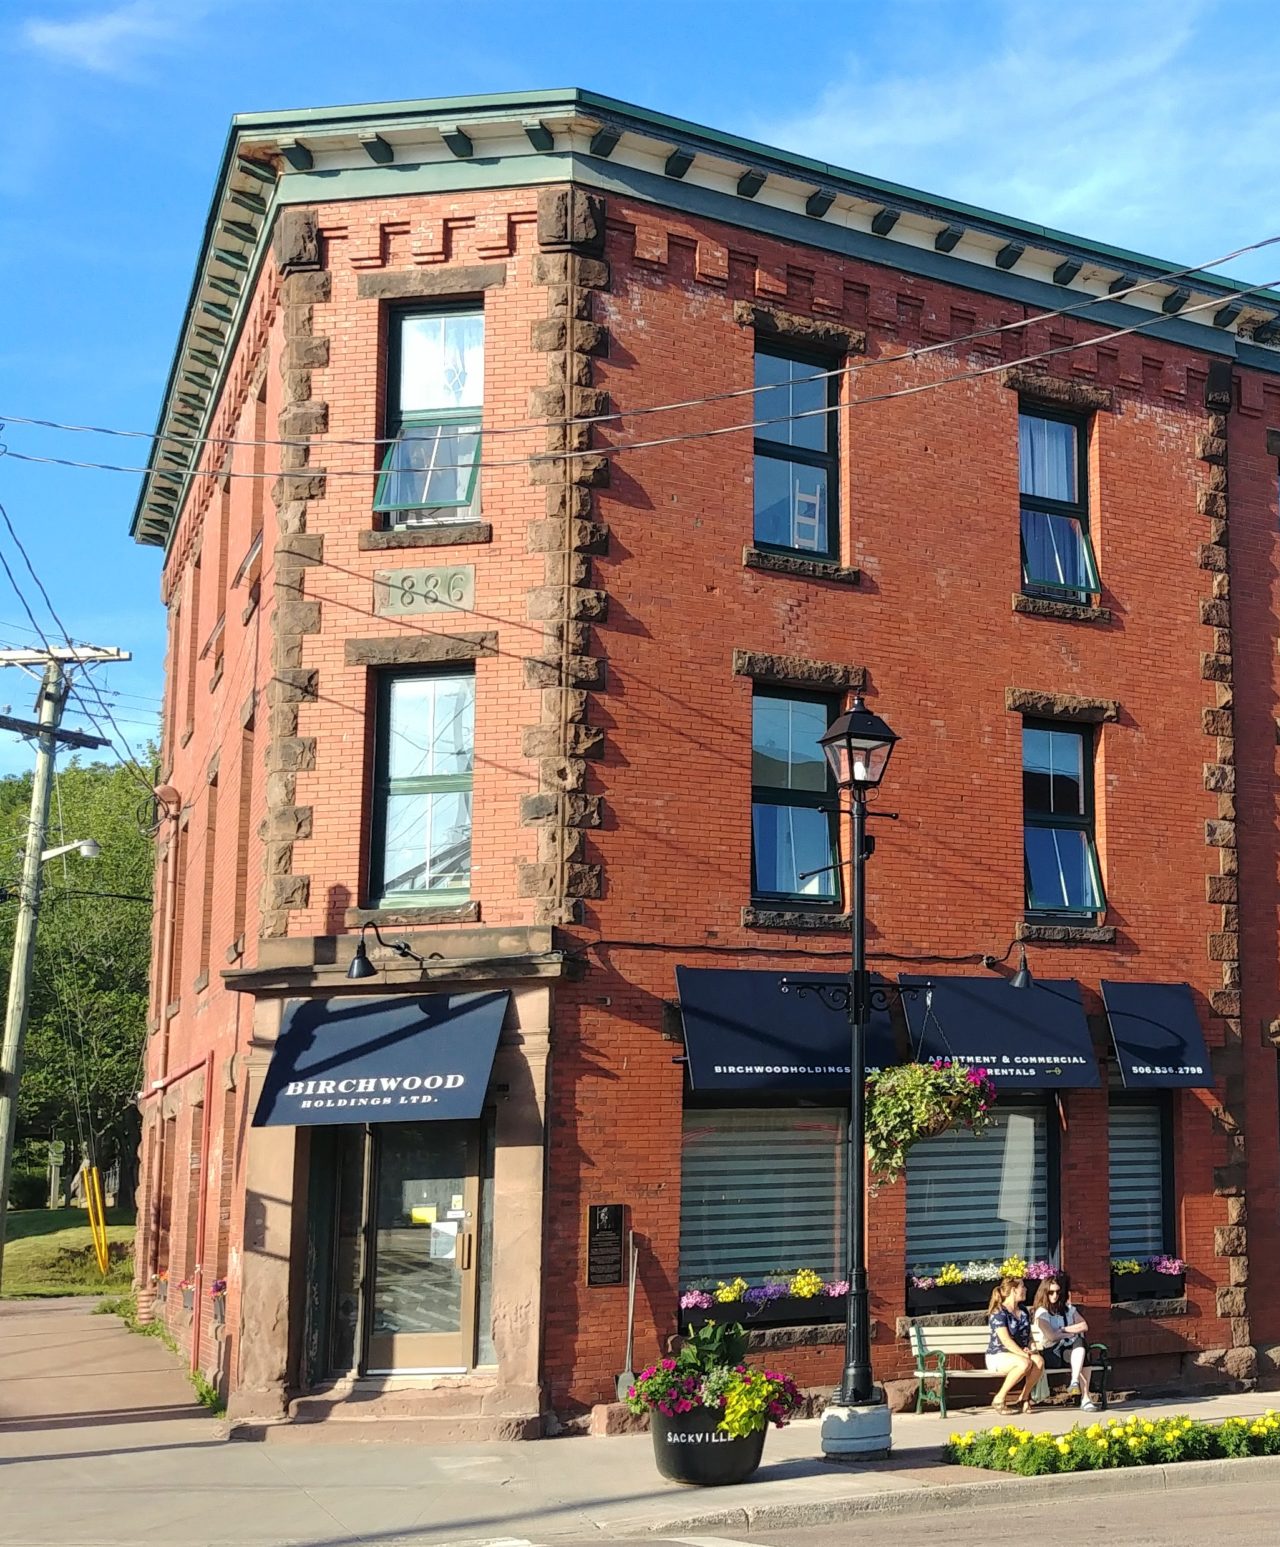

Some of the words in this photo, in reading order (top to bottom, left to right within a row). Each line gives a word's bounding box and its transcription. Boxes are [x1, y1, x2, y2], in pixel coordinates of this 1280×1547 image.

[928, 1055, 997, 1064] APARTMENT
[1002, 1055, 1011, 1064] &
[1014, 1056, 1087, 1064] COMMERCIAL
[987, 1068, 1036, 1076] RENTALS
[1131, 1066, 1203, 1074] 506.536.2798
[285, 1074, 465, 1096] BIRCHWOOD
[301, 1097, 392, 1109] HOLDINGS
[399, 1095, 438, 1105] LTD.
[667, 1431, 735, 1443] SACKVILLE
